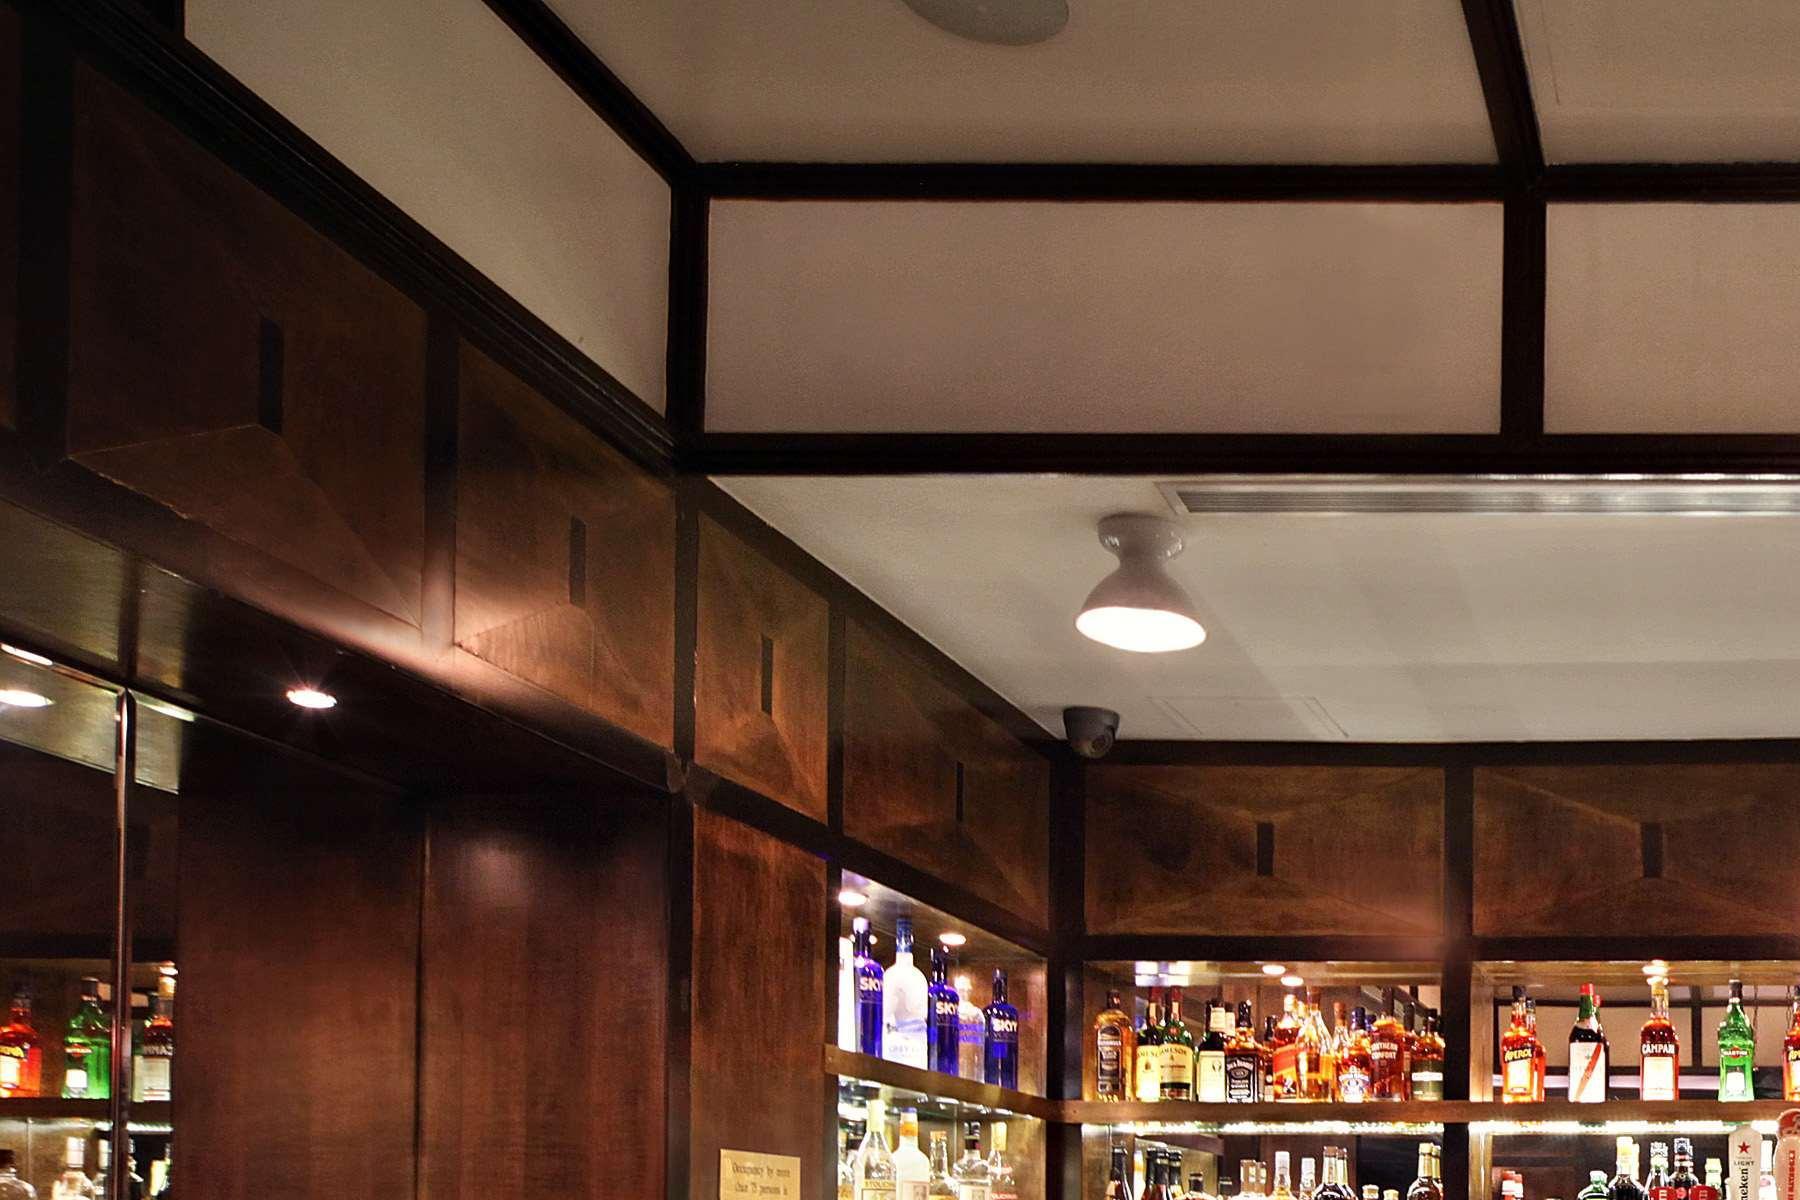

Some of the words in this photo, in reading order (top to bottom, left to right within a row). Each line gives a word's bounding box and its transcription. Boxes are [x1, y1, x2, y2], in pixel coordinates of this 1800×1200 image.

[992, 1018, 1017, 1032] SKYY
[1504, 1048, 1533, 1062] APEROL
[1642, 1043, 1675, 1055] CAMPARI
